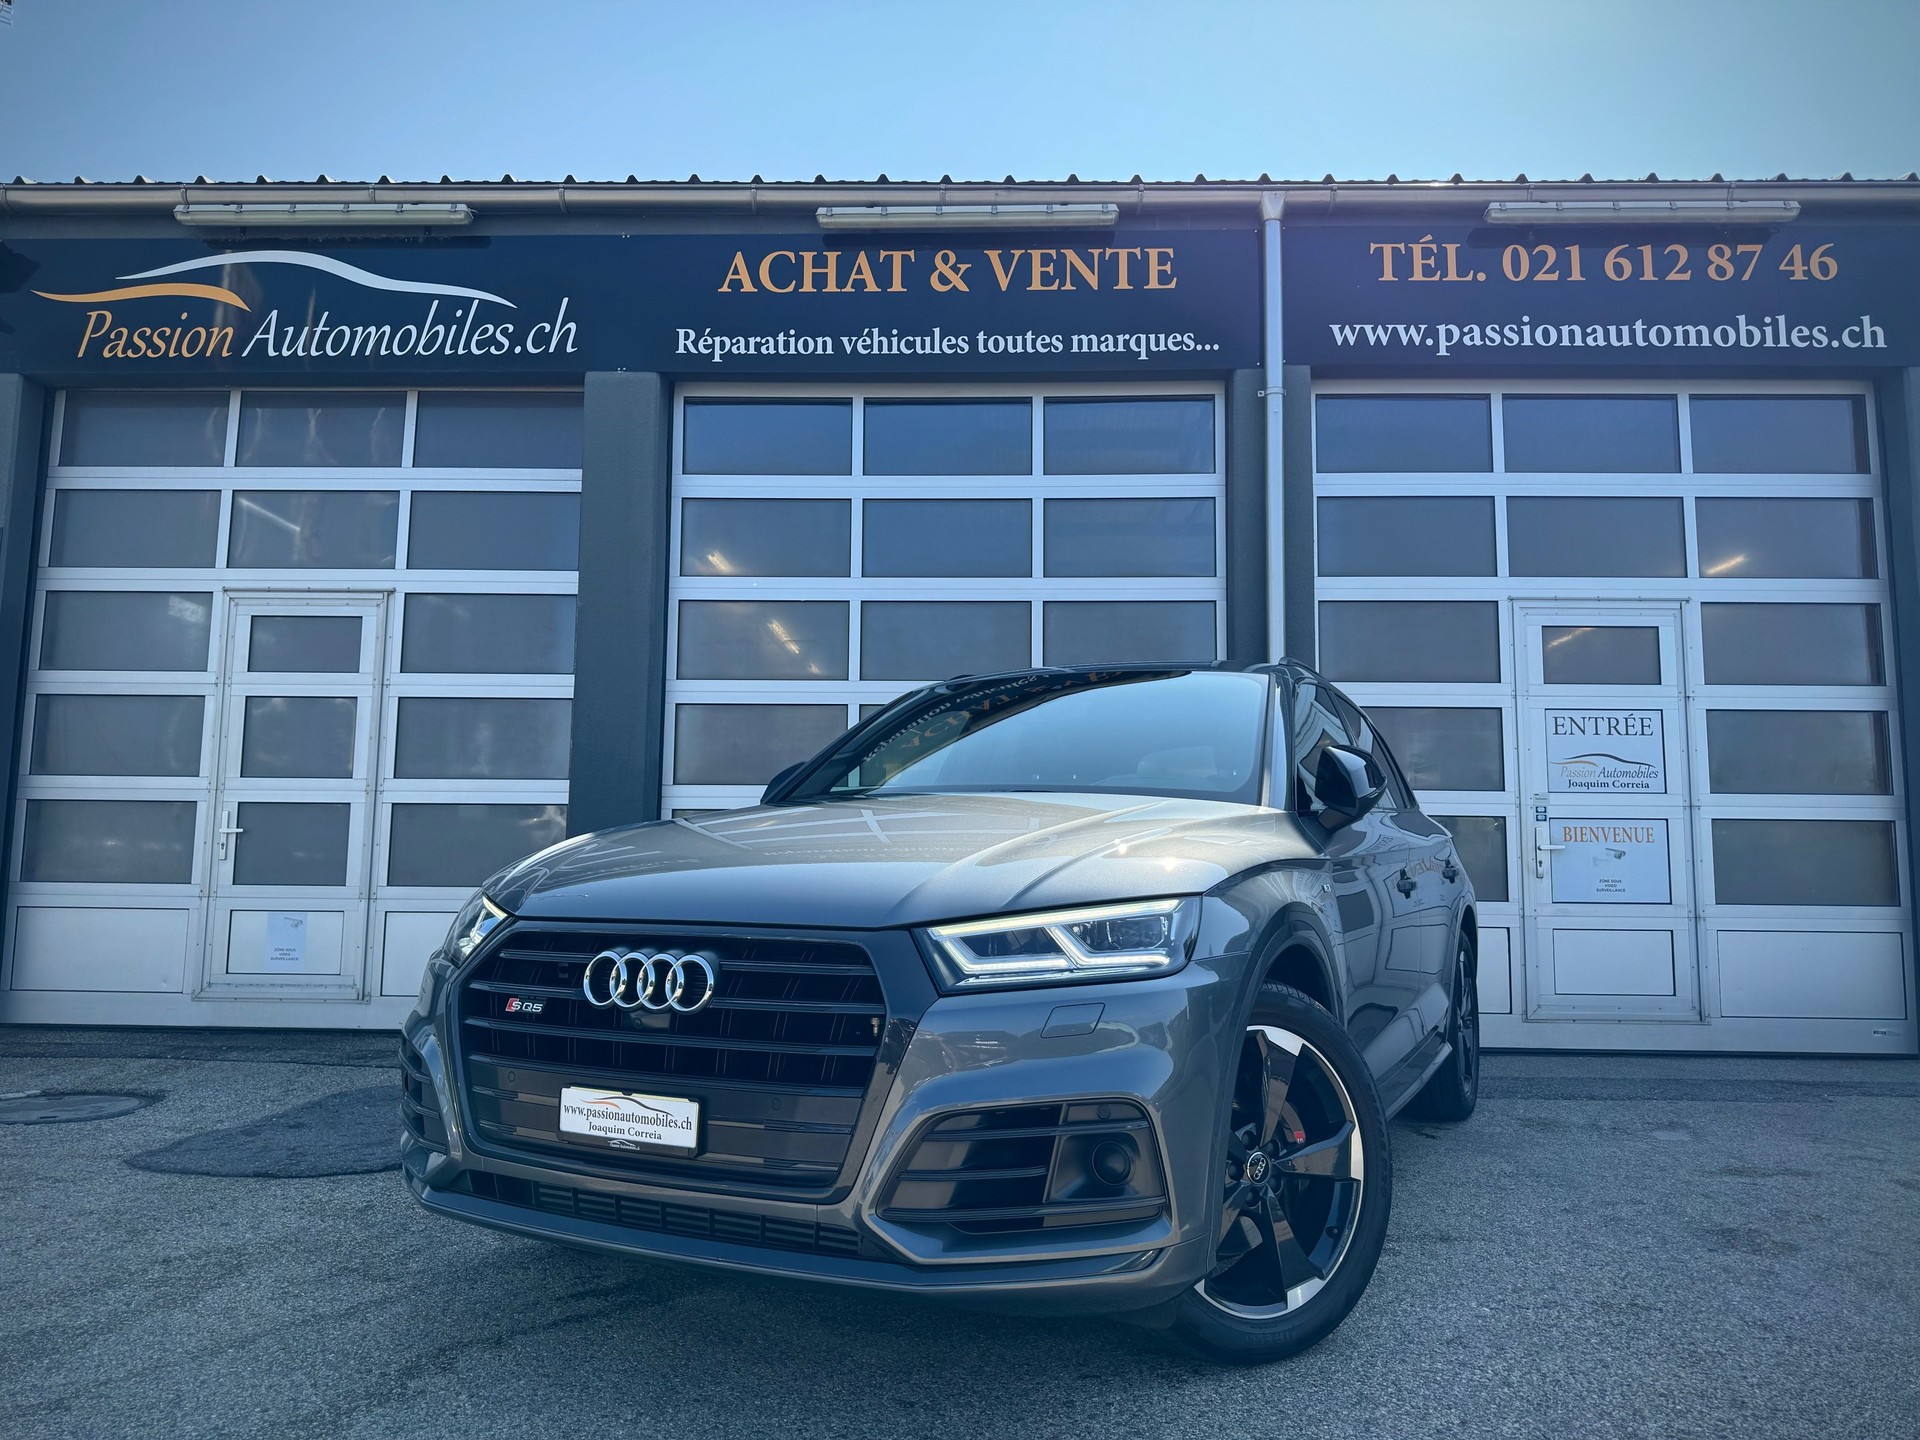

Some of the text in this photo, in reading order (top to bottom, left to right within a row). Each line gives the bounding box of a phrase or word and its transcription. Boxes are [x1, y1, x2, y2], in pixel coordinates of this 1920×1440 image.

[718, 246, 1178, 293] ACHAT & VENTE
[1369, 233, 1838, 282] TÉL. 021 612 87 46
[77, 297, 578, 359] Passion Automobiles.ch
[1328, 314, 1888, 356] www.passionautomobiles.ch
[675, 326, 1220, 363] Réparation véhicules toutes marques...
[1552, 713, 1655, 737] ENTRÉE
[1560, 766, 1660, 779] Passion Automobiles
[1567, 779, 1651, 790] Joaquim Correia
[1562, 826, 1656, 844] BIENVENUE
[510, 1000, 544, 1013] SQ5
[563, 1103, 693, 1131] www.passionautomobiles.ch
[588, 1121, 662, 1141] Joaquim Correia
